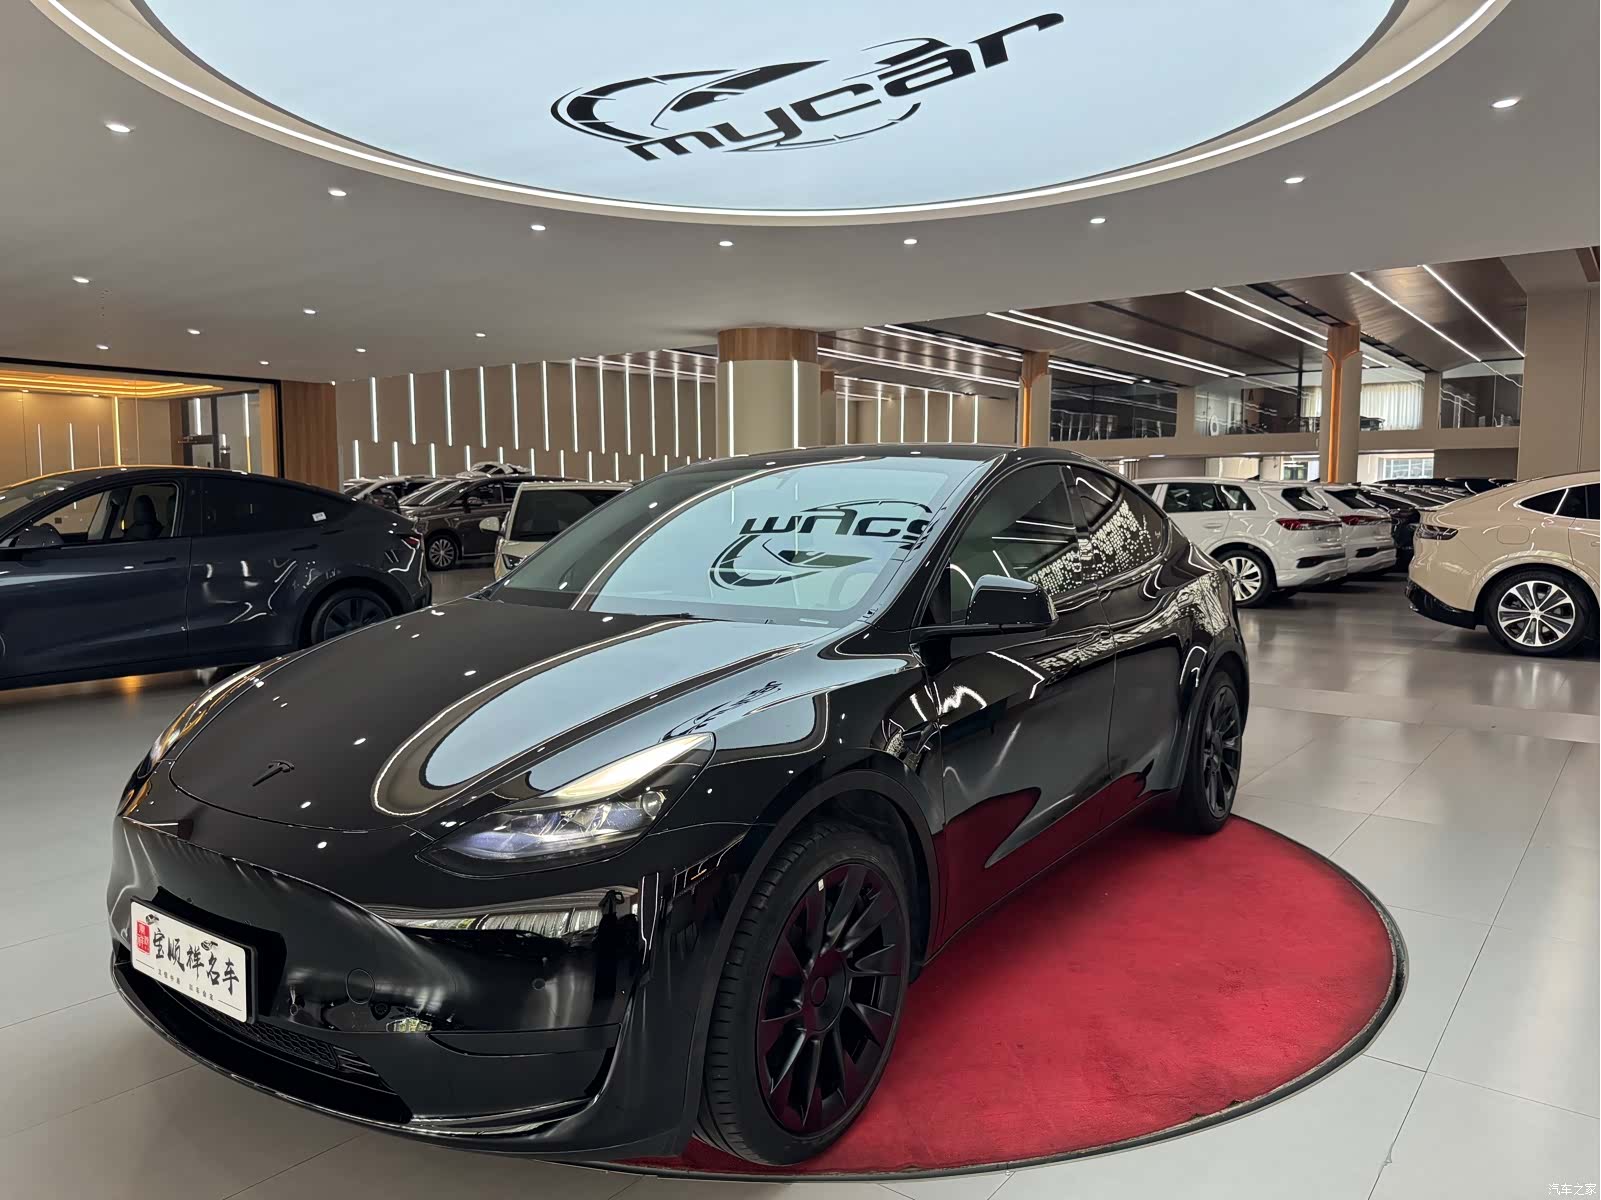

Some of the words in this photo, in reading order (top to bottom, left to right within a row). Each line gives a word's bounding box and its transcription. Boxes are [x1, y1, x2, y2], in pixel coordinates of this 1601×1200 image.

[624, 12, 1065, 162] mycar
[152, 927, 240, 996] 宝顺祥名车
